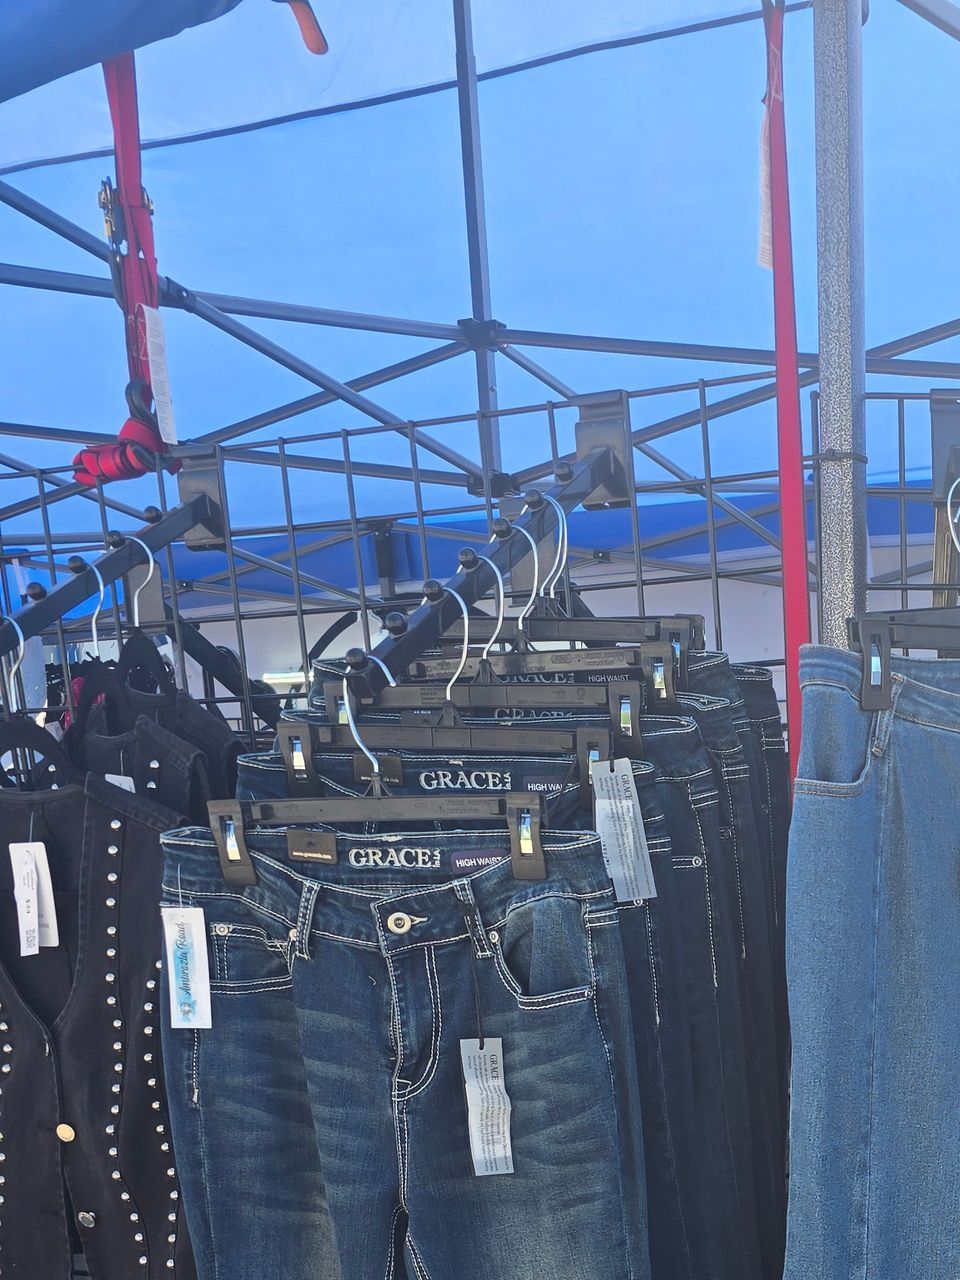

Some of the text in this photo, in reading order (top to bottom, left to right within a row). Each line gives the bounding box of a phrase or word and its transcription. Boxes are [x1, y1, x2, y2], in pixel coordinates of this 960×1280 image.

[588, 674, 629, 683] HIGH WAIST
[419, 771, 503, 790] GRACE
[527, 783, 547, 791] HIGH
[620, 773, 633, 801] GRACE
[349, 848, 433, 868] GRACE
[455, 858, 476, 868] HIGH
[175, 921, 187, 950] Road
[489, 1053, 500, 1081] GRACE
